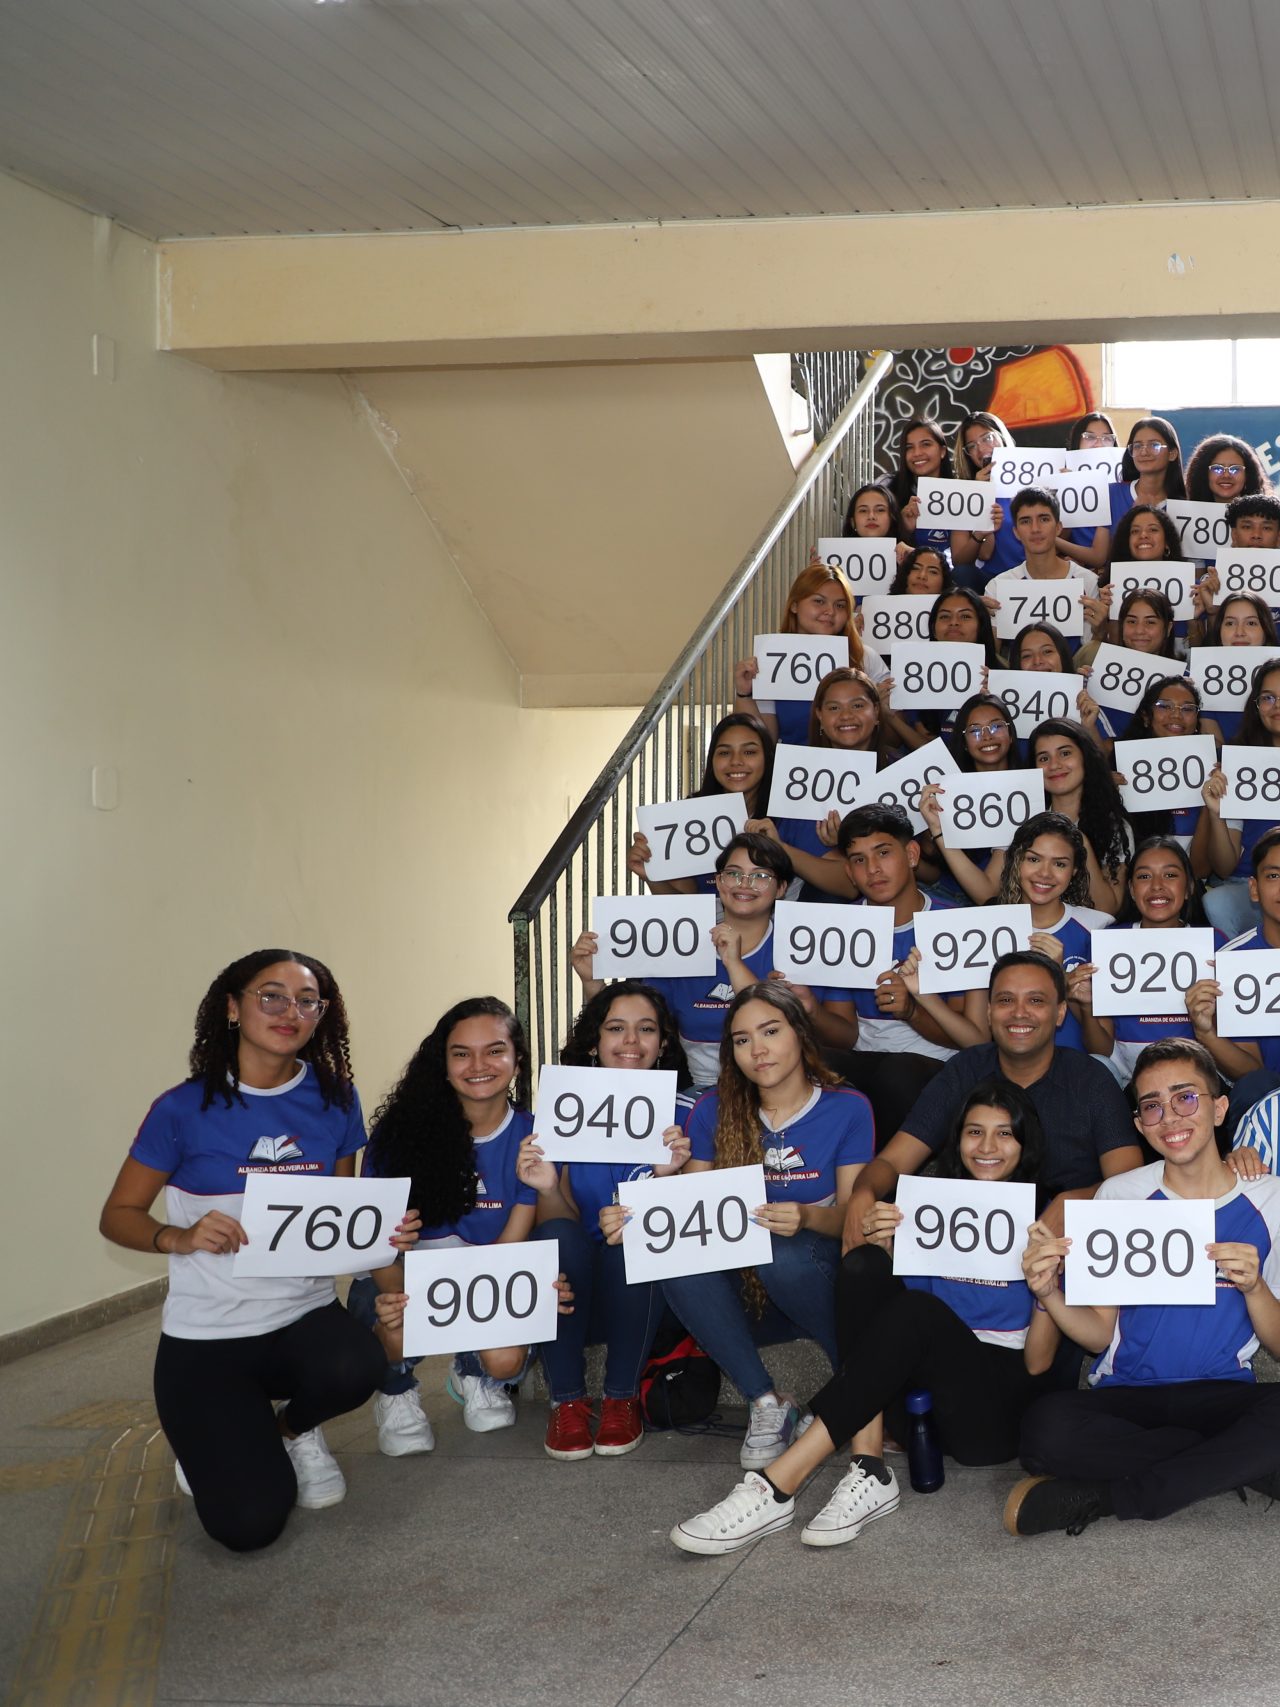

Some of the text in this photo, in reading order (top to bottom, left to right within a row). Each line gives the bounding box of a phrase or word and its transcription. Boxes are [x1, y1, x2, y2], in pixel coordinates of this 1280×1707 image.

[928, 491, 985, 518] 800
[1176, 516, 1230, 545] 780
[1010, 596, 1071, 624] 740
[766, 652, 836, 684] 760
[903, 662, 972, 692] 800
[1203, 665, 1260, 696] 88
[1001, 688, 1069, 721] 840
[786, 766, 860, 804] 800
[1132, 755, 1205, 793] 880
[954, 791, 1030, 829] 860
[654, 815, 737, 860] 780
[609, 918, 699, 957] 900
[789, 926, 876, 968] 900
[933, 926, 1018, 971] 920
[1109, 952, 1197, 993] 920
[553, 1093, 655, 1140] 940
[279, 1164, 305, 1172] OLIVEIRA
[305, 1163, 319, 1171] LIMA
[266, 1205, 382, 1252] 760
[643, 1195, 747, 1255] 940
[915, 1204, 1015, 1255] 960
[1086, 1228, 1194, 1278] 980
[427, 1271, 538, 1328] 900
